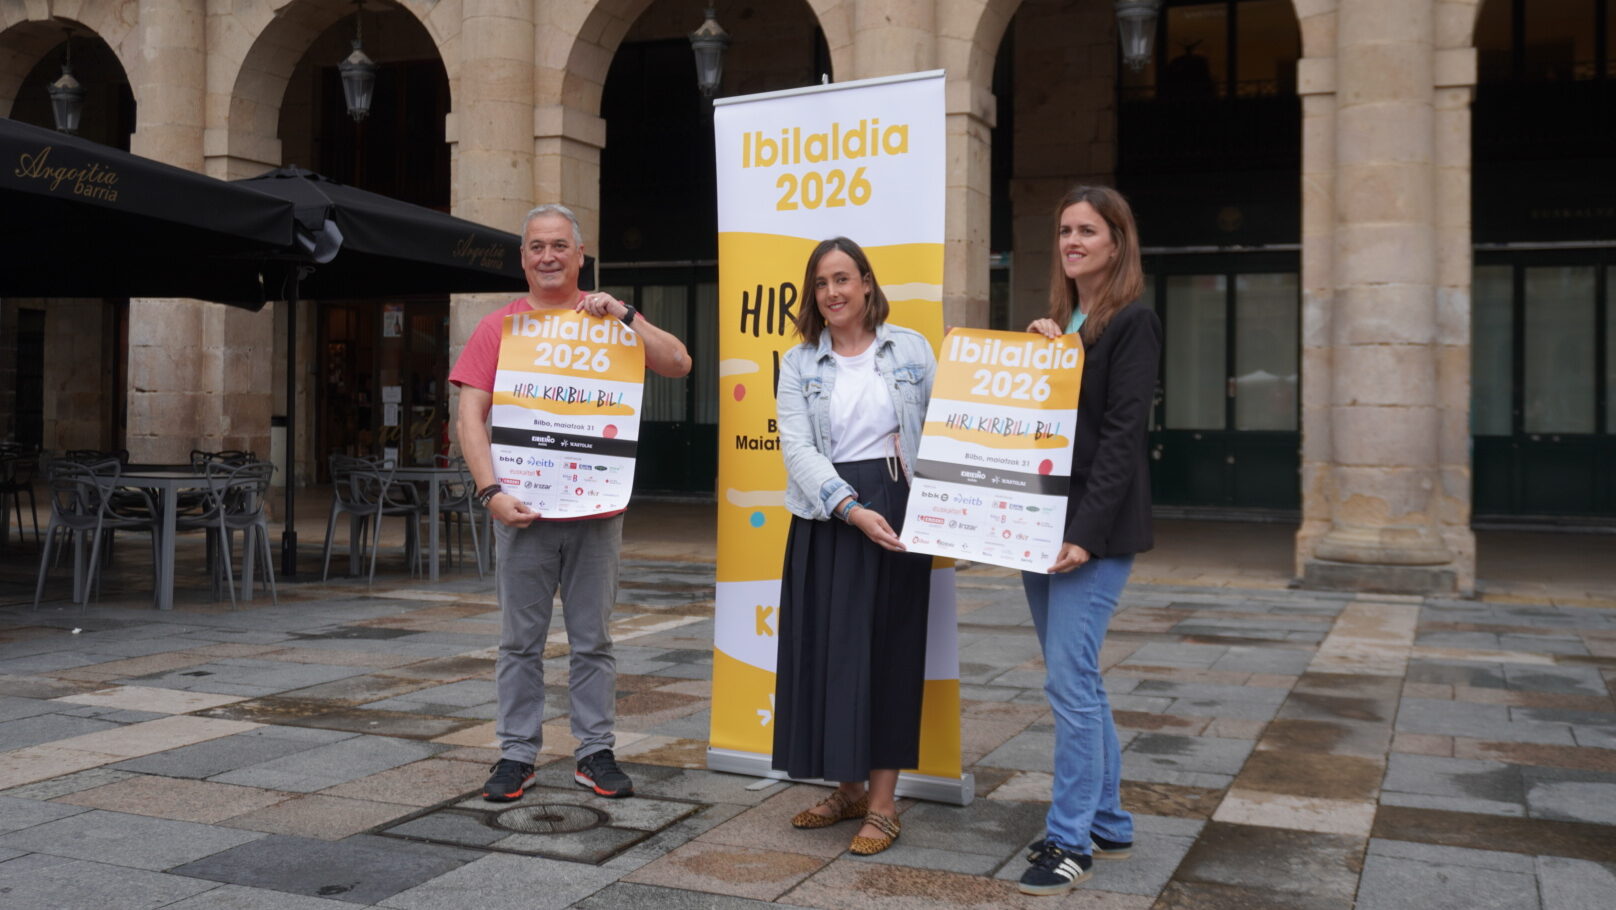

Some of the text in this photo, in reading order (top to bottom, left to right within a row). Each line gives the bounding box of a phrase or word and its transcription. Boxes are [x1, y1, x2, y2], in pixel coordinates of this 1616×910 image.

[742, 118, 909, 169] Ibilaldia
[14, 146, 119, 191] Argoitia
[74, 182, 119, 202] barria
[775, 166, 872, 212] 2026
[740, 282, 799, 338] HIR
[512, 314, 637, 346] Ibilaldia
[534, 342, 611, 373] 2026
[949, 336, 1079, 369] Ibilaldia
[513, 383, 538, 399] HIRI
[543, 385, 591, 404] KIRIBILI
[971, 369, 1051, 402] 2026
[534, 419, 553, 429] Bilbo,
[554, 421, 585, 431] maiatzak
[945, 413, 974, 430] HIRI
[978, 415, 1030, 437] KIRIBILI
[736, 435, 780, 450] Maiat
[536, 459, 554, 467] eitb
[965, 452, 985, 463] Bilbo,
[987, 455, 1020, 467] maiatzak
[921, 491, 939, 499] bbk
